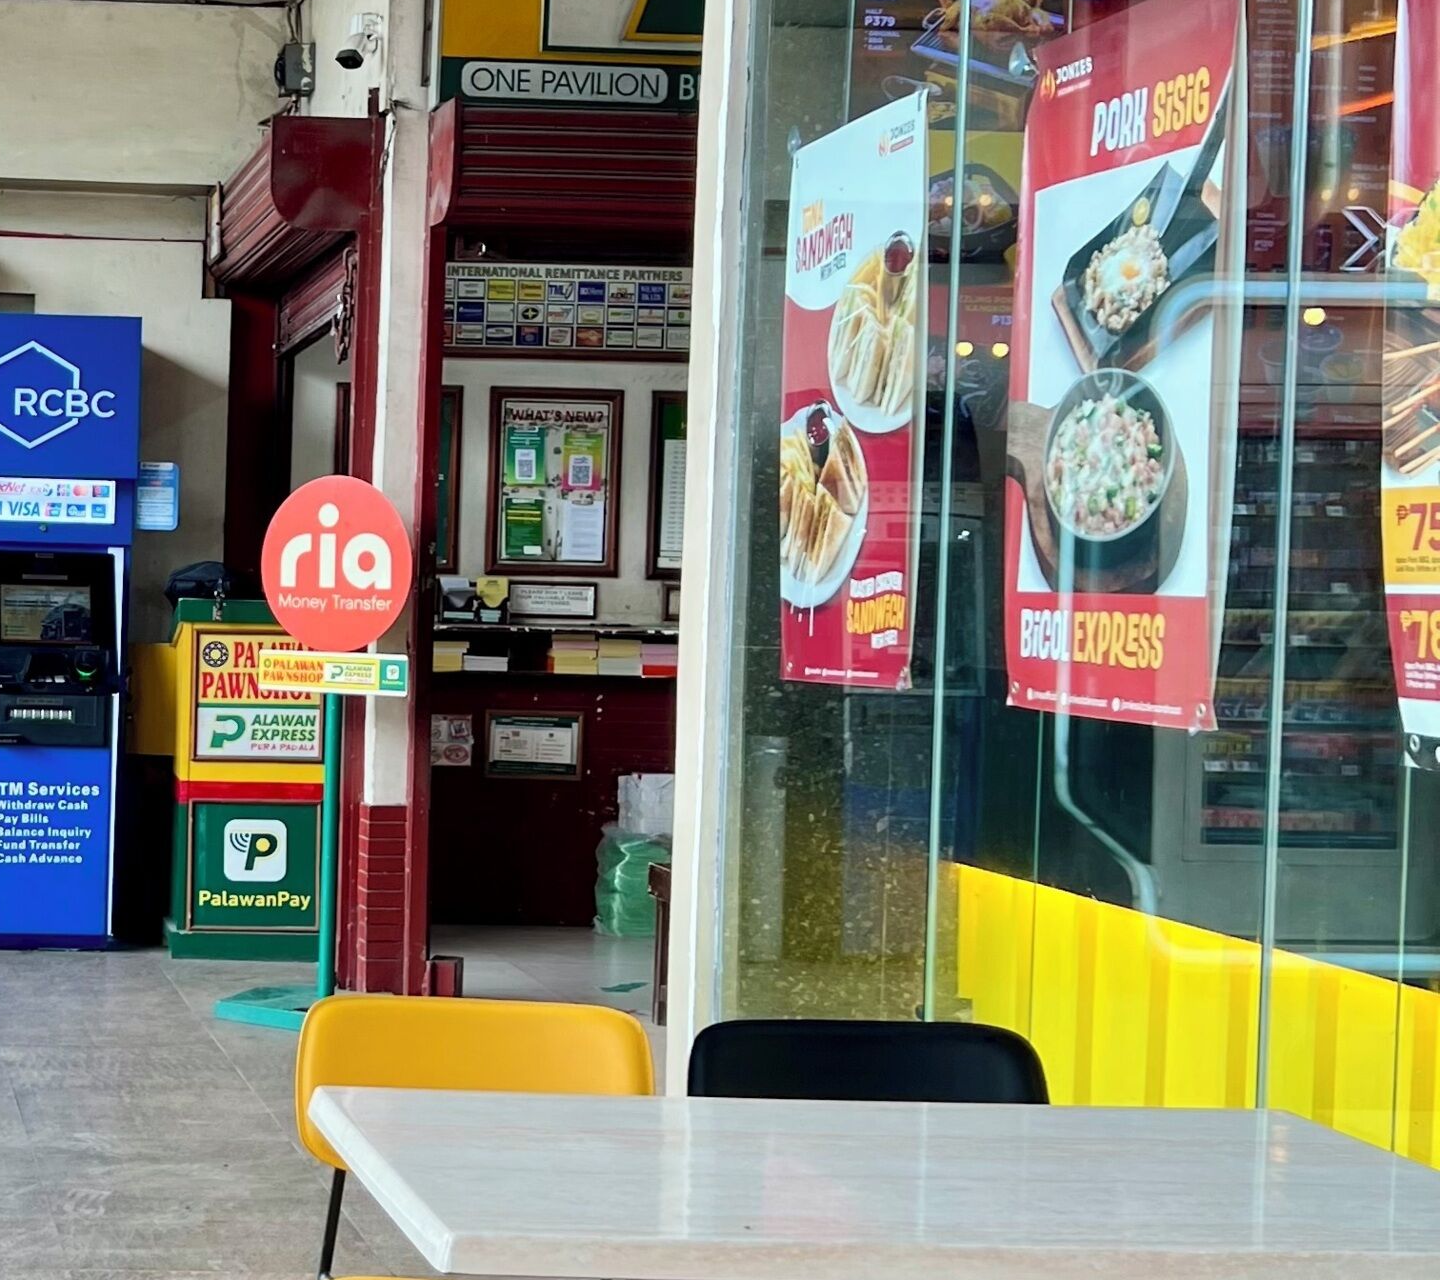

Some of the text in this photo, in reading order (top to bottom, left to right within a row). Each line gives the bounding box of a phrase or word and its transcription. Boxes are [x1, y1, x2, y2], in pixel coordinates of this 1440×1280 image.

[864, 15, 896, 28] P379
[1056, 57, 1093, 85] JONIES
[471, 68, 531, 93] ONE
[541, 70, 660, 98] PAVILION
[1090, 87, 1148, 157] PORK
[447, 266, 683, 282] INTERNATIONAL REMITTANCE PARTNERS
[14, 387, 116, 418] RCBC
[510, 409, 604, 423] WHAT'S NEW?
[7, 501, 41, 517] VISA
[280, 503, 393, 590] ria
[278, 593, 392, 612] Money Transfer
[1073, 611, 1165, 669] EXPRESS
[273, 658, 324, 670] PALAWAN
[263, 671, 324, 683] PAWNSHOP
[250, 714, 316, 727] ALAWAN
[250, 728, 316, 742] EXPRESS
[250, 743, 276, 751] PERA
[28, 782, 100, 796] Services
[58, 800, 88, 810] Cash
[22, 813, 49, 824] Bills
[48, 827, 92, 839] Inquiry
[29, 840, 80, 850] Transfer
[29, 853, 82, 864] Advance
[198, 890, 311, 910] PalawanPay
